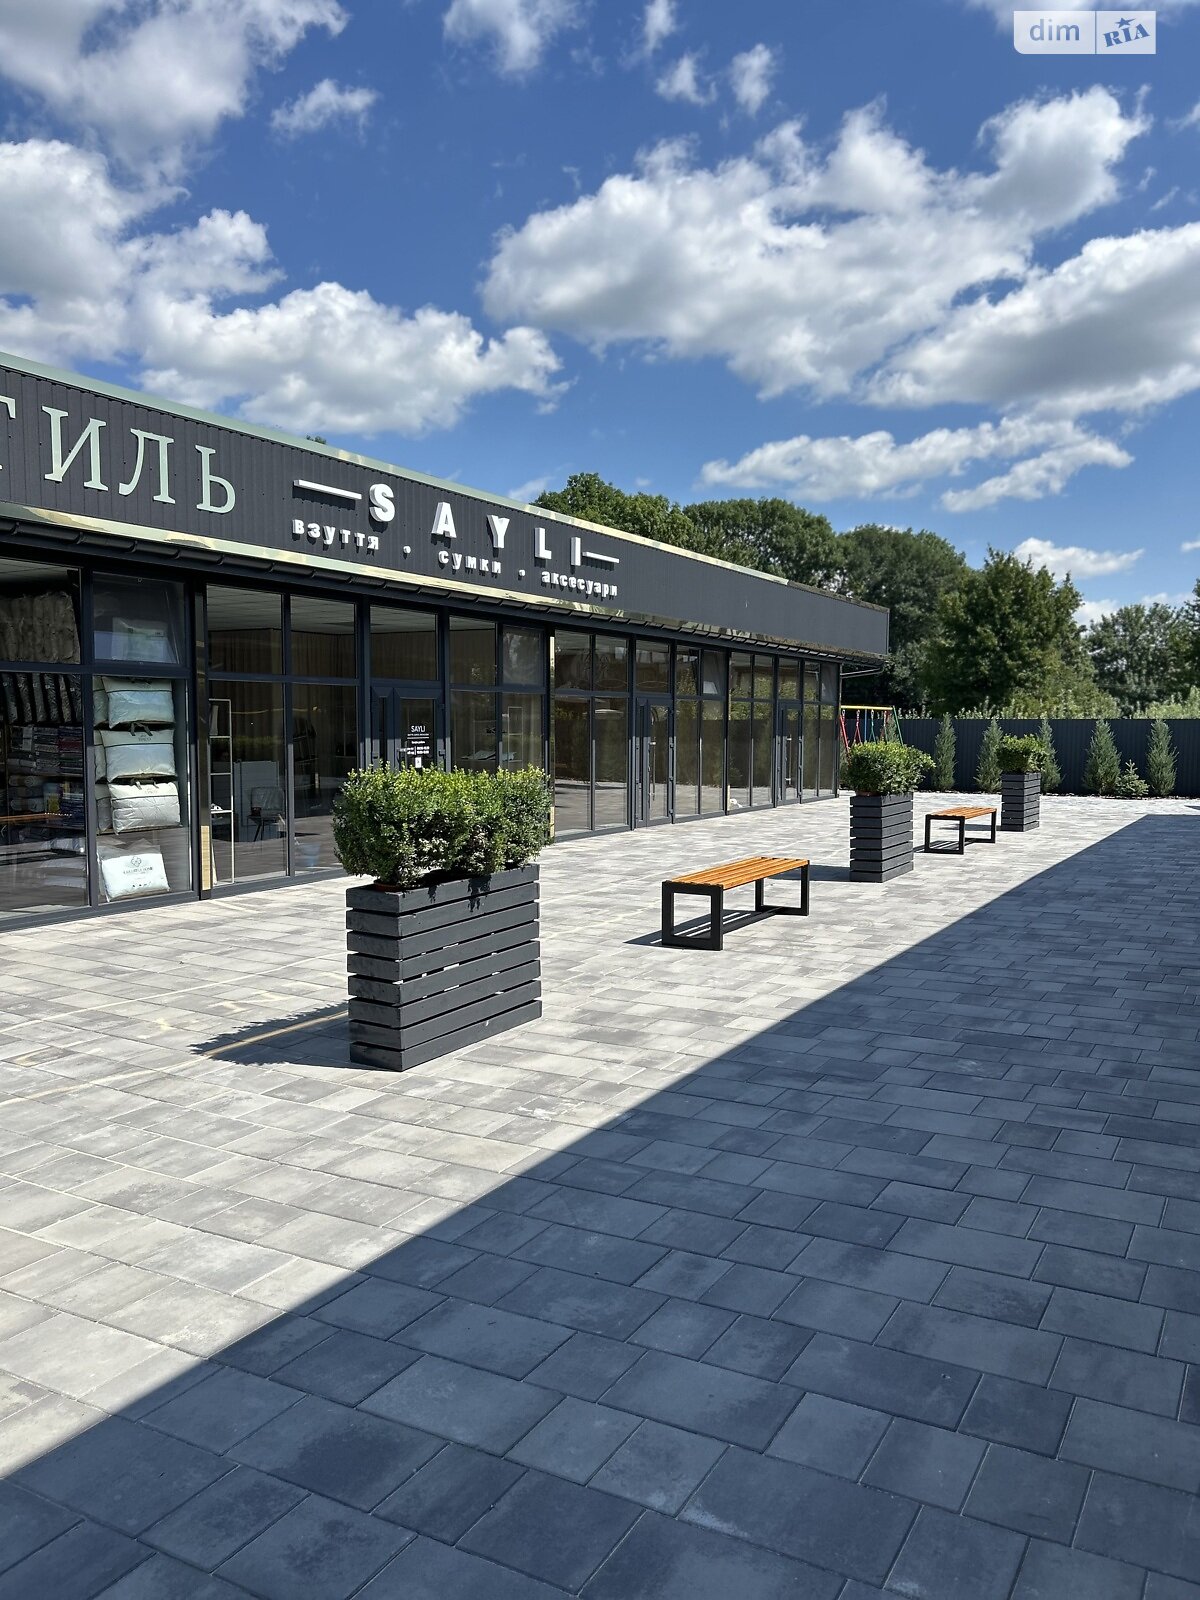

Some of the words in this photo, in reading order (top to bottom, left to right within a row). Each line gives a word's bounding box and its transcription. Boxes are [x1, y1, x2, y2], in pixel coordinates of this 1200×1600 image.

[292, 519, 380, 551] взуття
[438, 550, 502, 575] сумки
[541, 569, 618, 598] аксесуари
[368, 483, 582, 567] SAYLI
